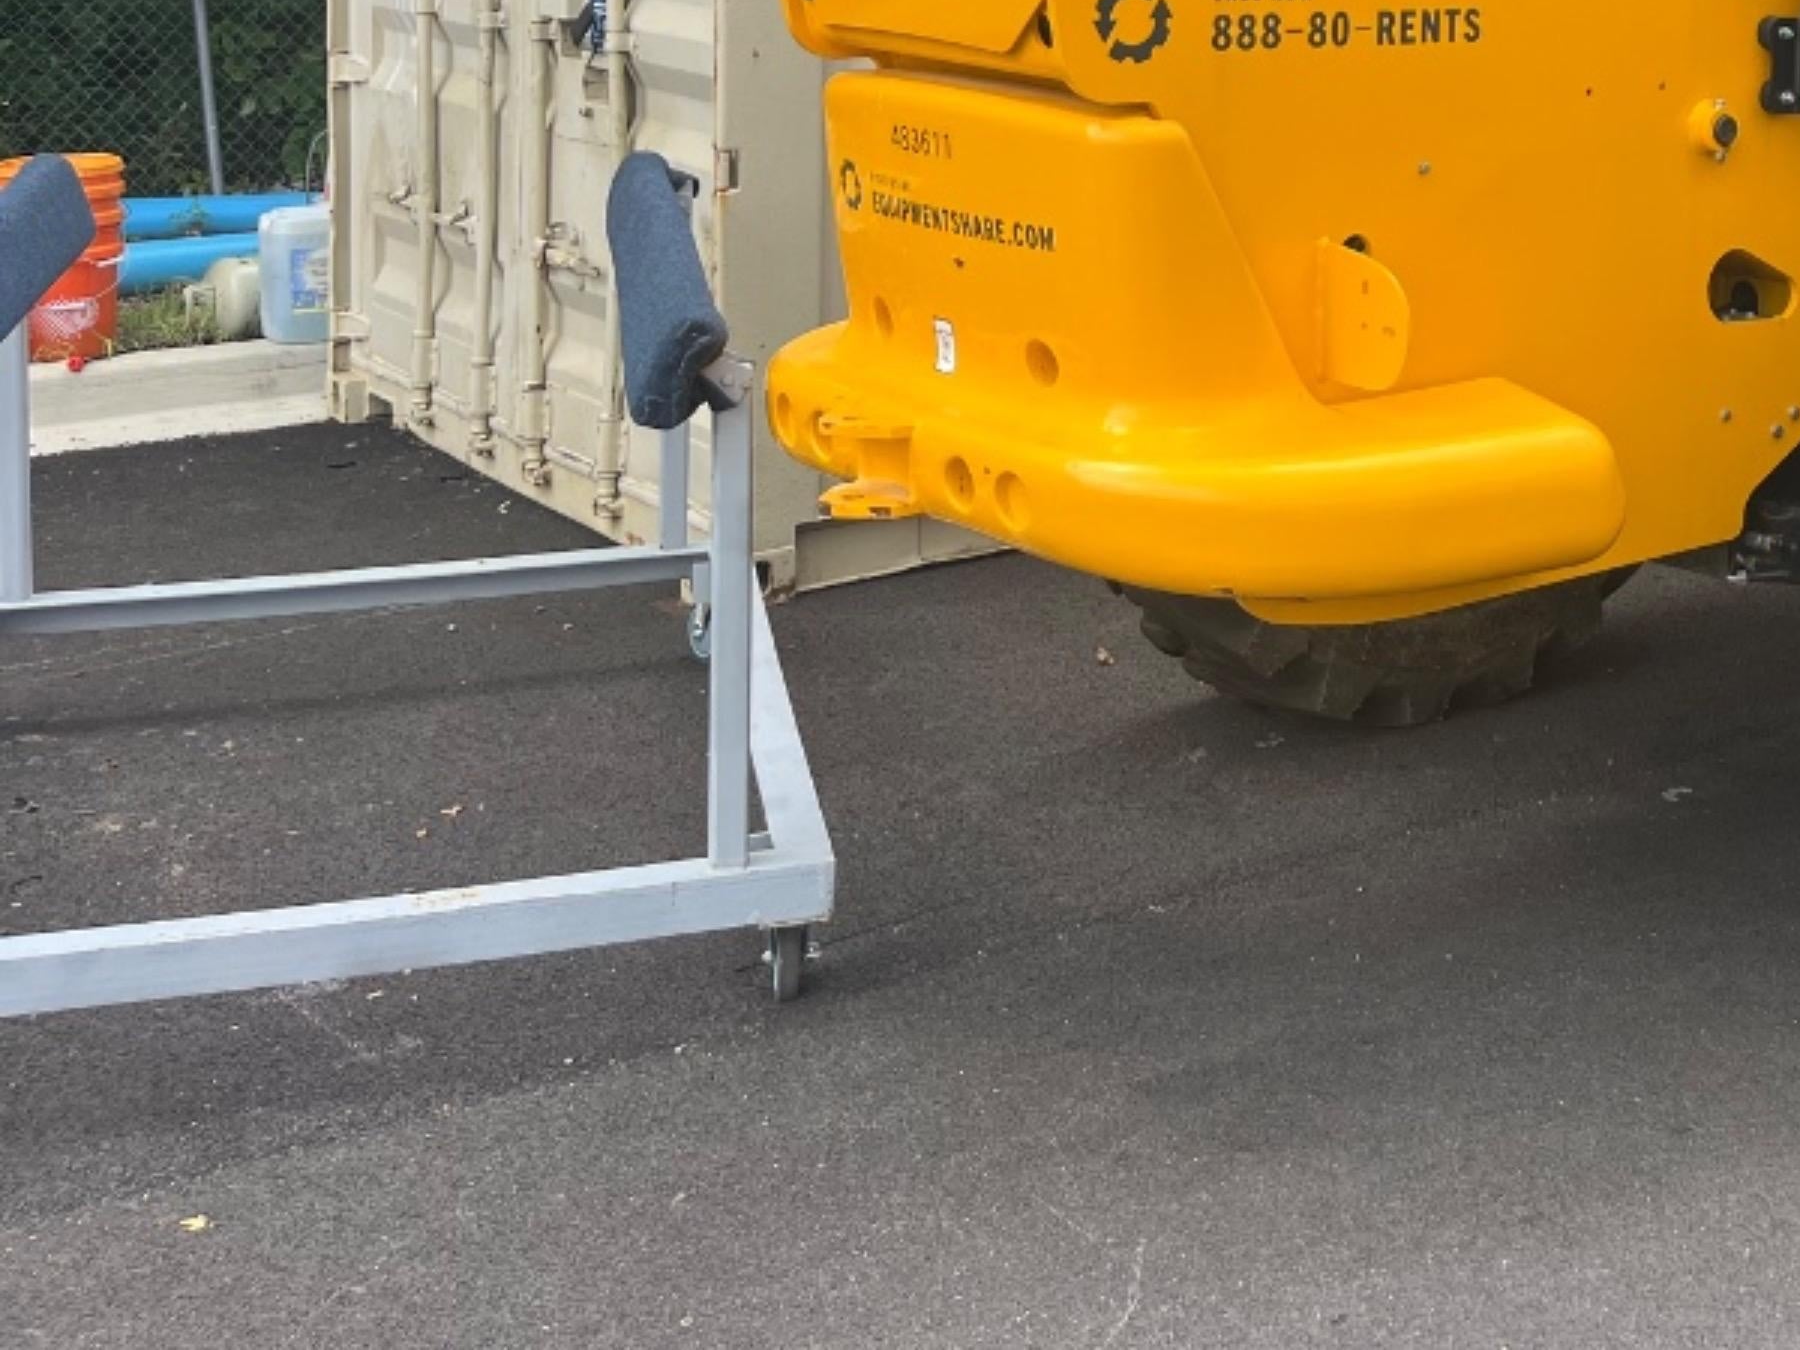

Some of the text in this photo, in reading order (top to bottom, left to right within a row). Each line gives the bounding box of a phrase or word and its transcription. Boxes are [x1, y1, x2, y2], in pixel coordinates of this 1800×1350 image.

[1211, 8, 1481, 51] 888-80-RENTS
[891, 125, 952, 159] 483611
[872, 191, 1056, 252] EQUIPMENTSHARE.COM
